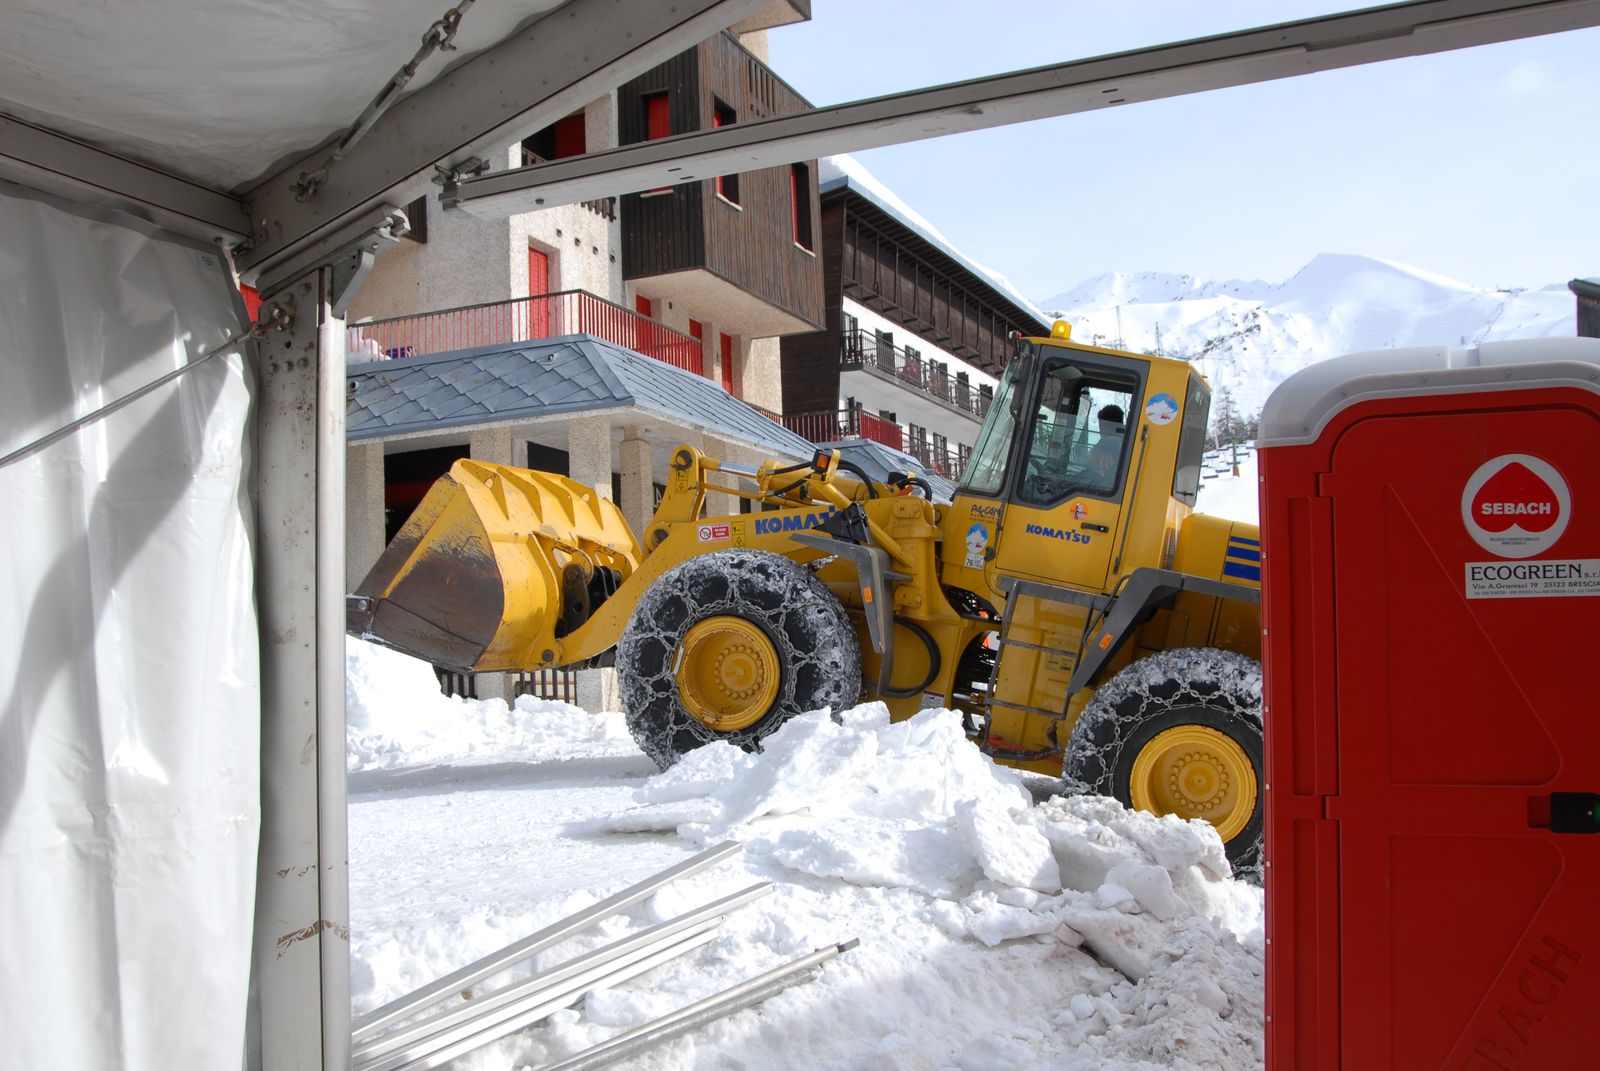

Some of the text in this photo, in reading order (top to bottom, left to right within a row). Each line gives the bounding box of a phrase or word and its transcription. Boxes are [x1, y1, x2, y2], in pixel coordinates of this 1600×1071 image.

[1481, 502, 1551, 515] SEBACH
[1025, 523, 1091, 545] KOMATSU
[1471, 564, 1582, 580] ECOGREEN
